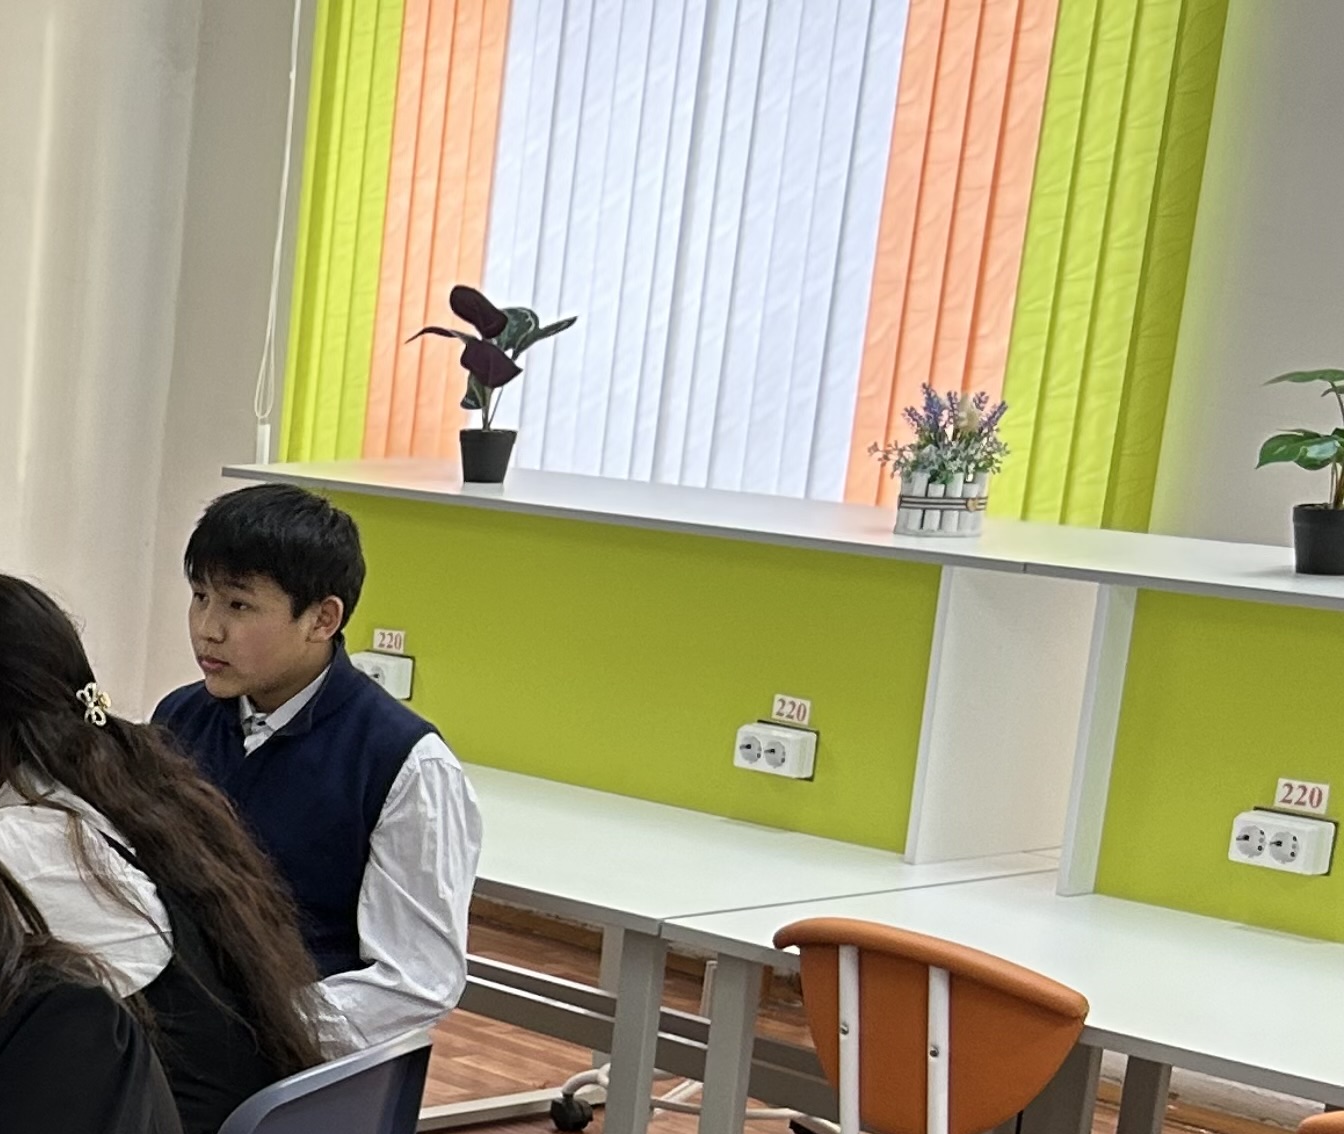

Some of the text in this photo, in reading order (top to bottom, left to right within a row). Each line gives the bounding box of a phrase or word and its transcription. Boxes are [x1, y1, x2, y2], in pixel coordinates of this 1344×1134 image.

[377, 631, 402, 650] 220
[775, 698, 807, 721] 220
[1279, 783, 1323, 808] 220
